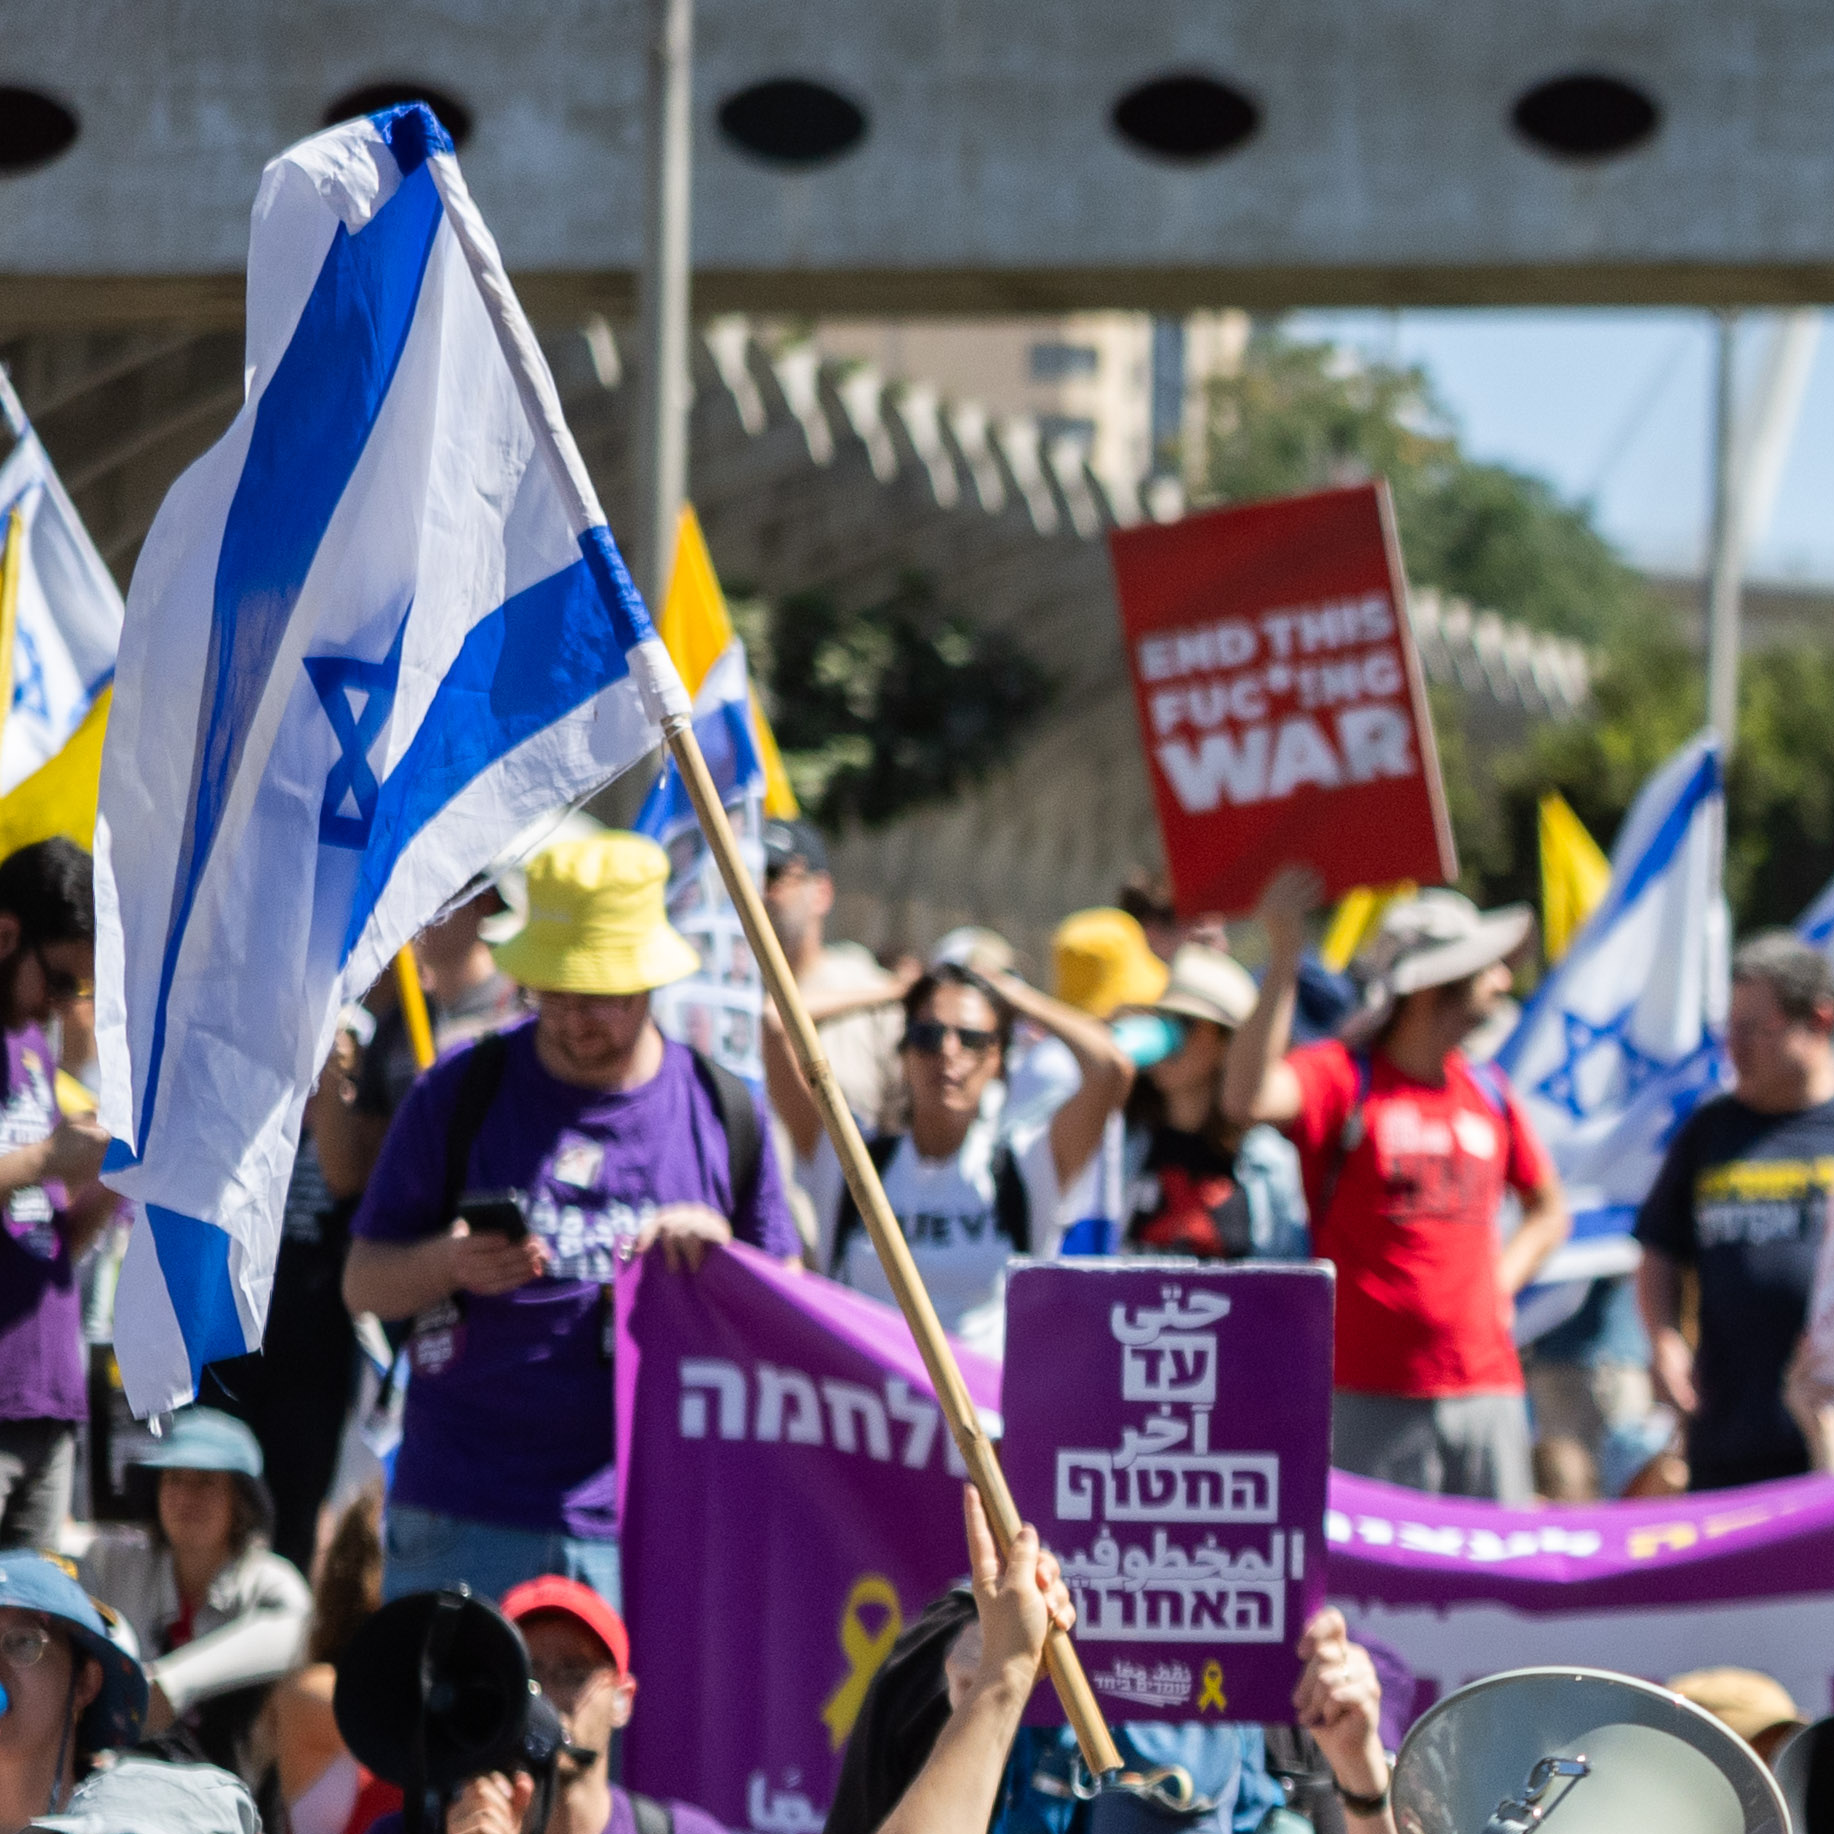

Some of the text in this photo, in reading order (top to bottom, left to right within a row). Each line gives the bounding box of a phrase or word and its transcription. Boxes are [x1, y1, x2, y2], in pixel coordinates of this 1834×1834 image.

[1137, 598, 1393, 682] END THIS
[1154, 703, 1414, 816] WAR
[1130, 1347, 1208, 1391] עד
[1067, 1464, 1270, 1520] החטוף
